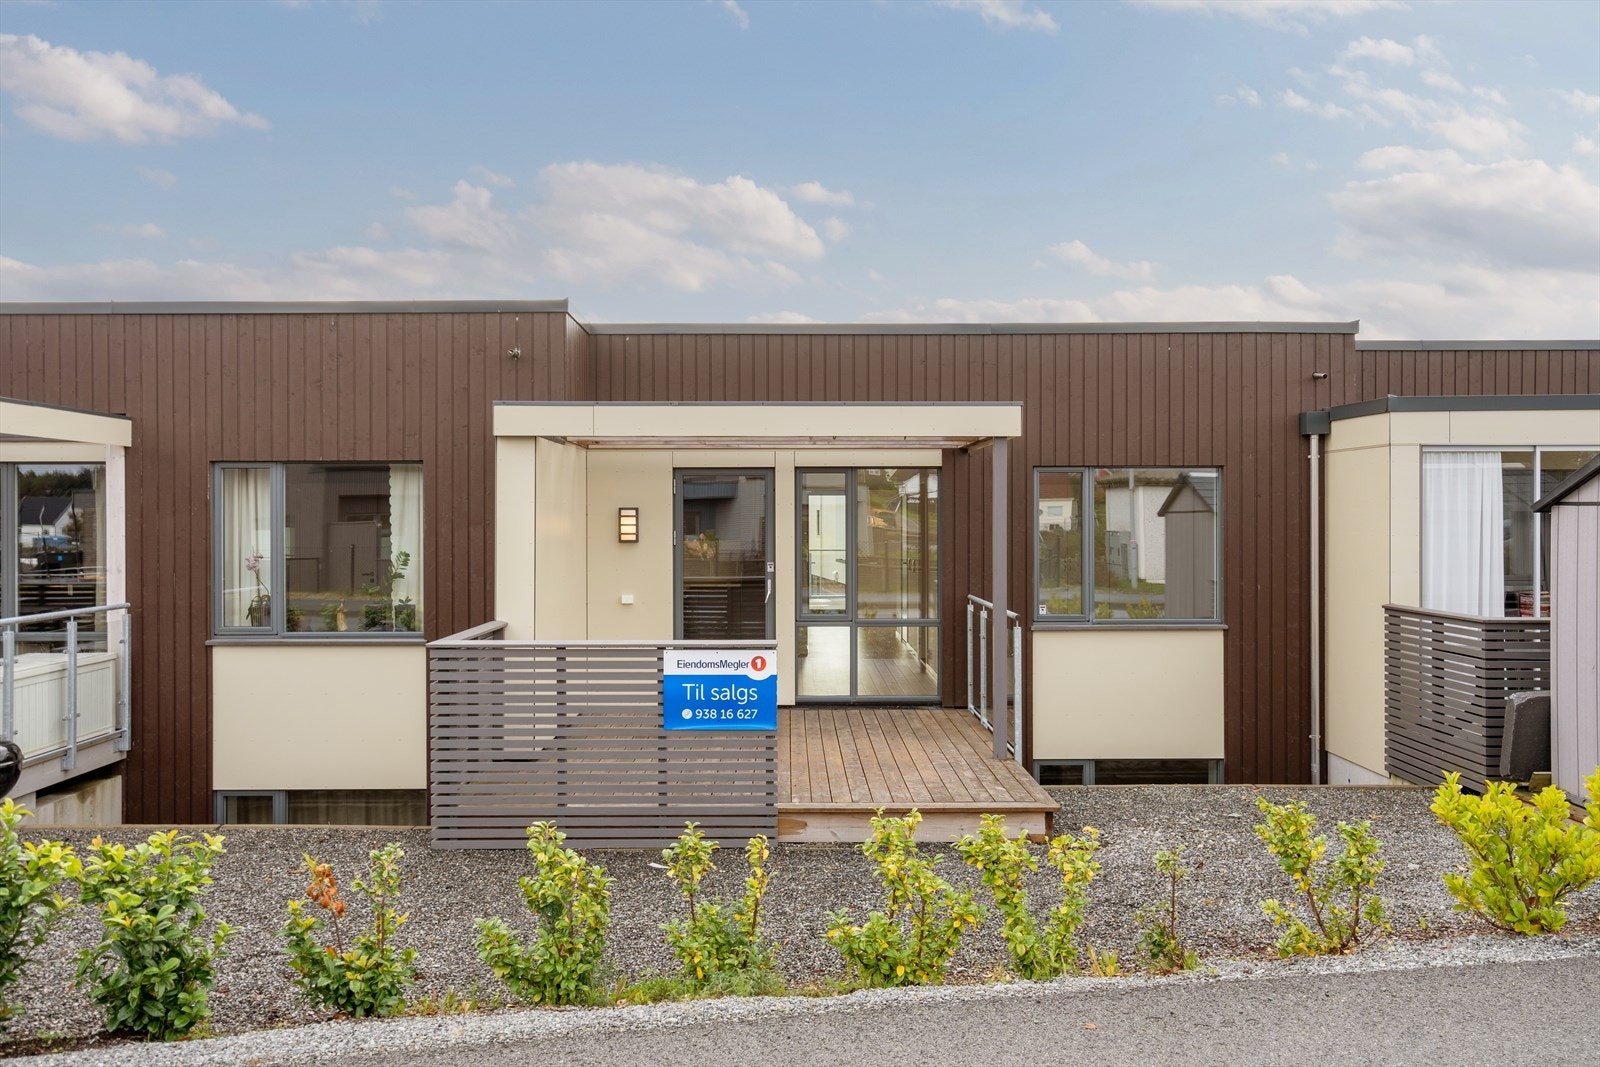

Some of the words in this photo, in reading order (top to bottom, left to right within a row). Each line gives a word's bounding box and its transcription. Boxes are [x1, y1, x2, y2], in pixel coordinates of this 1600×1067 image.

[676, 659, 750, 671] EiendomsMegler
[682, 683, 705, 701] Til
[711, 683, 758, 705] salgs
[695, 709, 717, 719] 938
[721, 709, 734, 719] 16
[737, 709, 758, 719] 627
